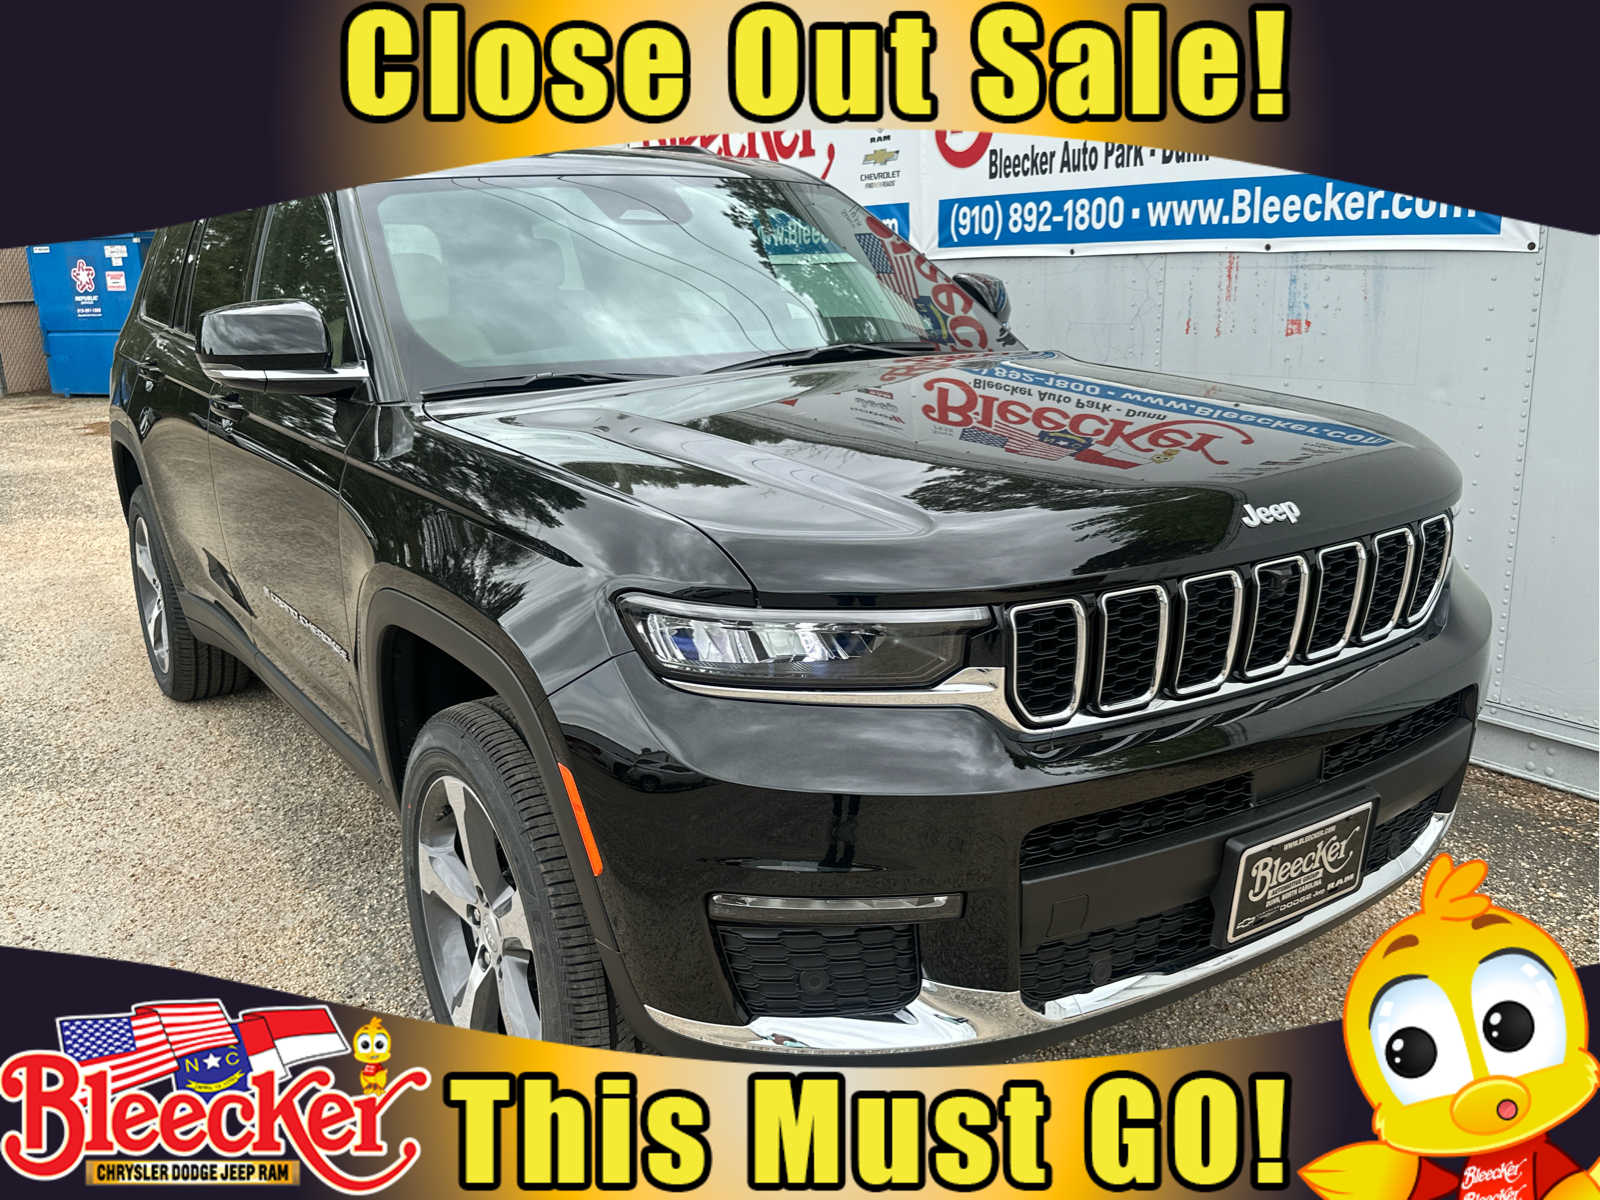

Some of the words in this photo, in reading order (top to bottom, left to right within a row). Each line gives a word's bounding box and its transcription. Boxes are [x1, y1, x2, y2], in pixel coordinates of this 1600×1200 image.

[870, 135, 891, 143] RAM
[988, 149, 1055, 180] Bleecker
[1059, 141, 1098, 173] Auto
[1104, 142, 1144, 170] Park
[860, 171, 901, 181] CHEVROLET
[951, 201, 1002, 242] (910)
[1008, 196, 1124, 233] 892-1800
[1241, 501, 1300, 528] Jeep
